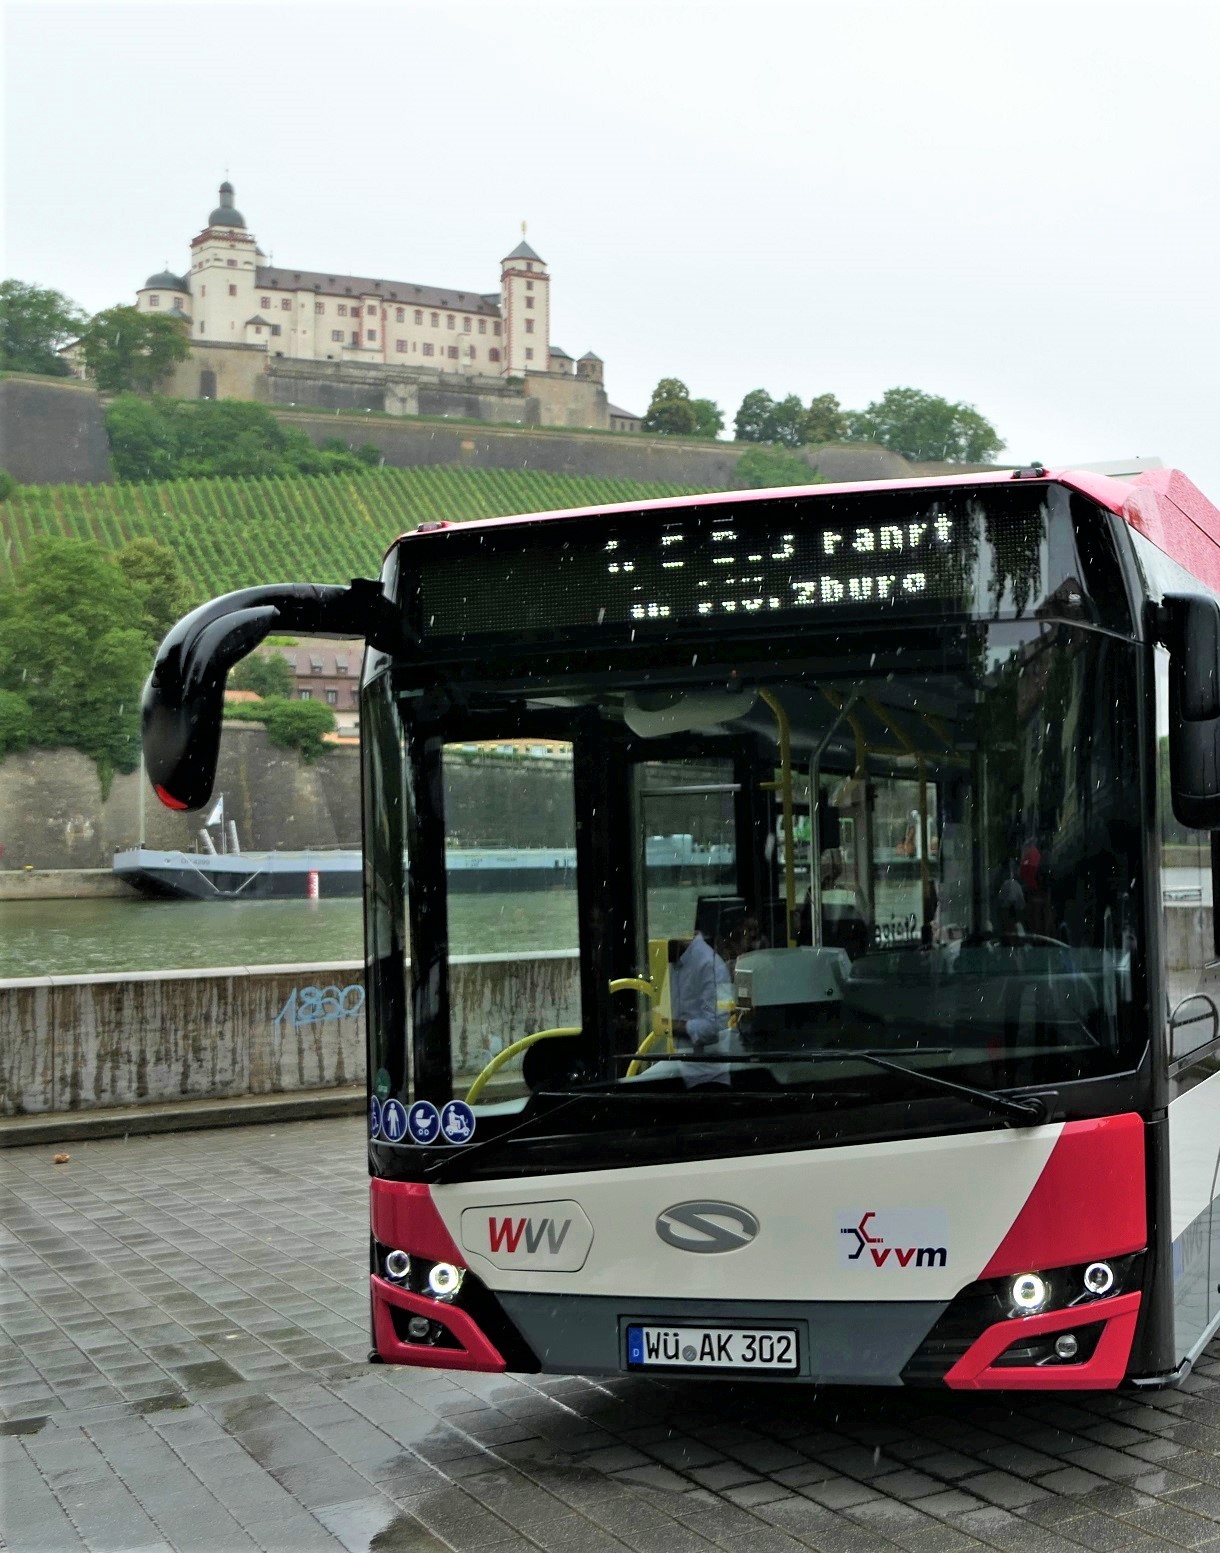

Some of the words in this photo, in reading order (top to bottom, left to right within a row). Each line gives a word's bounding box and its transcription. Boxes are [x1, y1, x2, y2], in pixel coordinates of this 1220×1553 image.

[488, 1216, 573, 1255] WVV
[869, 1246, 948, 1268] vvm
[632, 1348, 640, 1357] D
[699, 1332, 734, 1362] AK
[741, 1334, 793, 1364] 302
